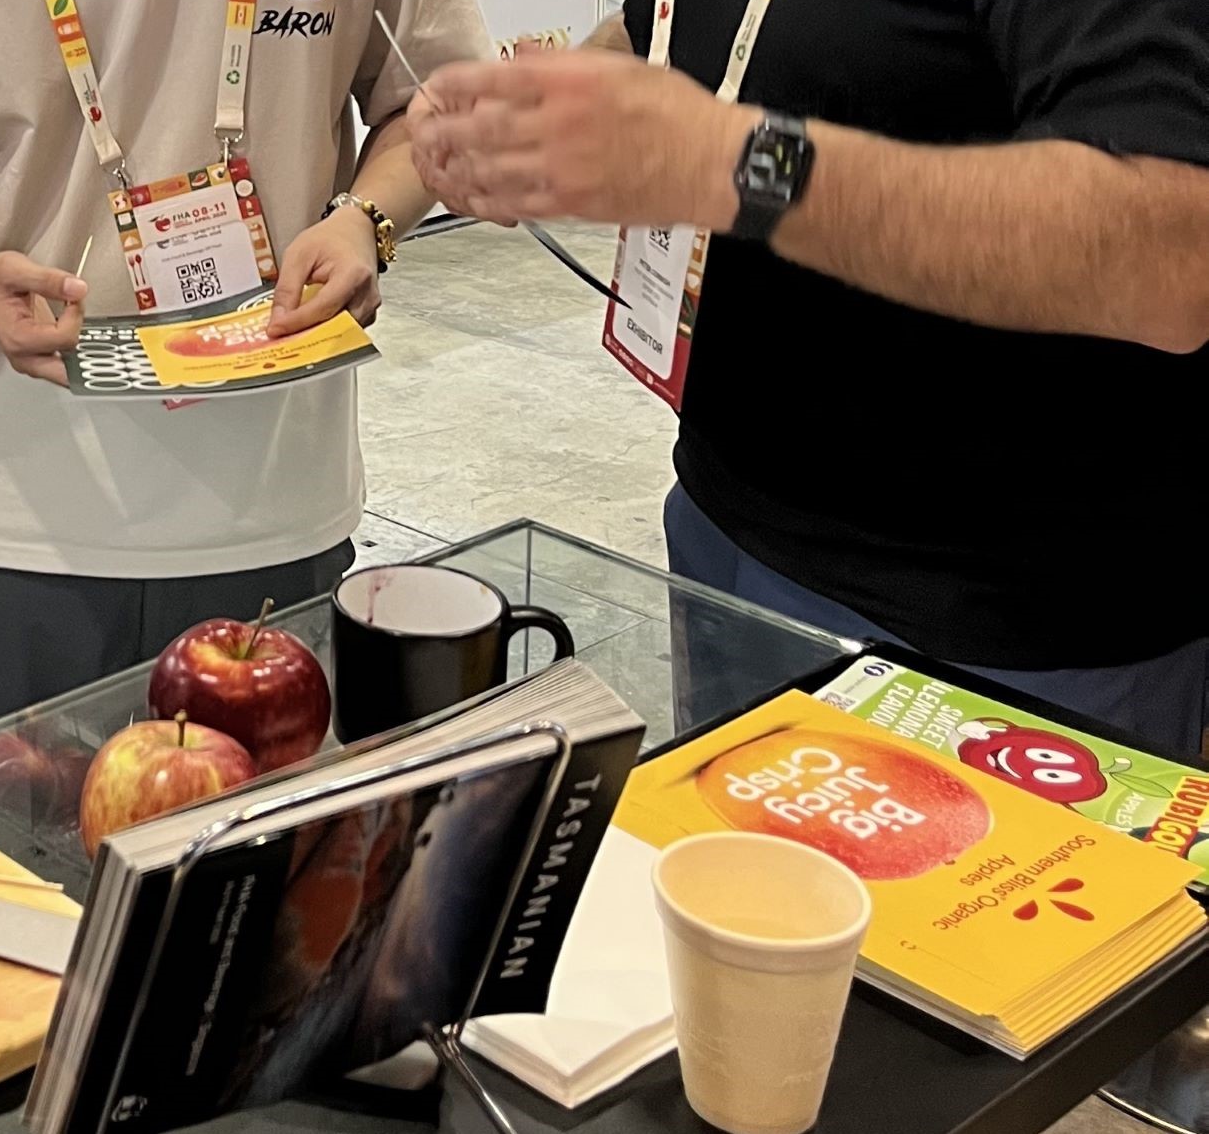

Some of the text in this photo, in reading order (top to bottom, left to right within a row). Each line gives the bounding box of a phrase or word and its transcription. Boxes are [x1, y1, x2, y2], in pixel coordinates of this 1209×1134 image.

[252, 6, 336, 40] BARON
[626, 317, 664, 355] EXHIBITOR
[919, 704, 963, 750] SWEET
[724, 746, 843, 802] Crisp
[763, 766, 890, 825] Juicy
[829, 796, 928, 840] Big
[1116, 791, 1145, 826] APPLES
[499, 772, 602, 979] TASMANIAN
[959, 854, 1016, 887] Apples
[1024, 834, 1097, 878] Southern
[932, 894, 999, 930] Organic
